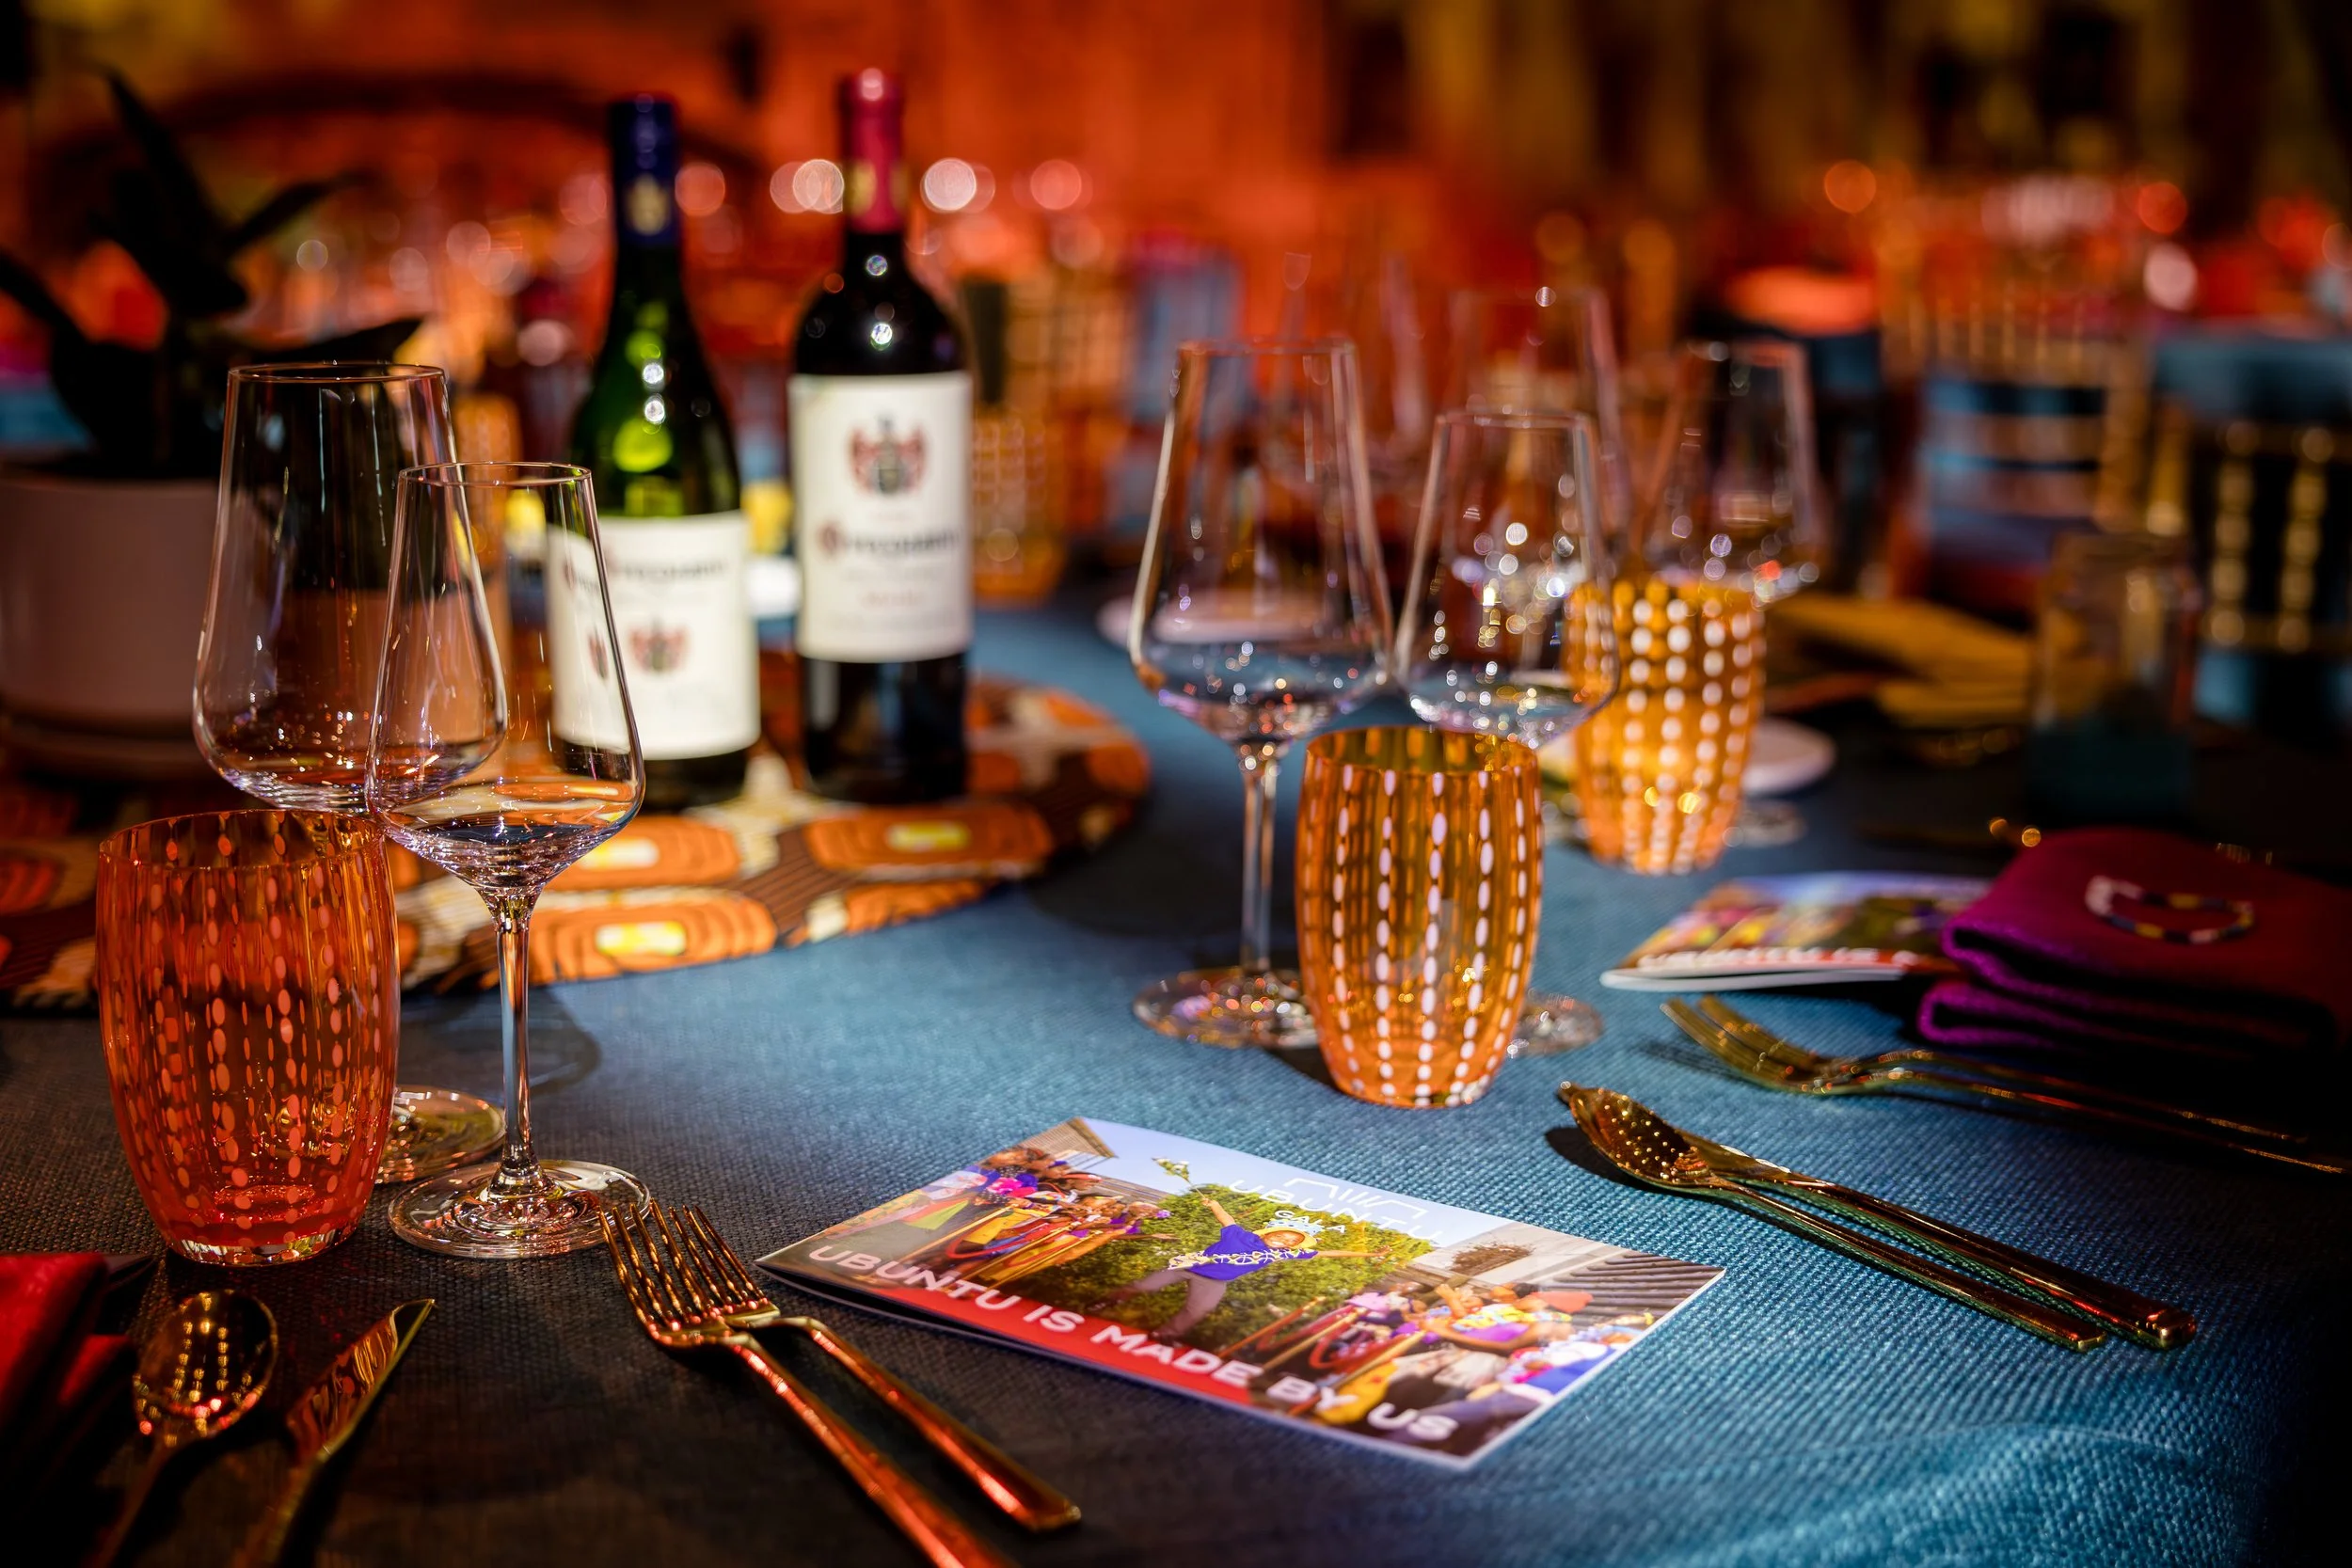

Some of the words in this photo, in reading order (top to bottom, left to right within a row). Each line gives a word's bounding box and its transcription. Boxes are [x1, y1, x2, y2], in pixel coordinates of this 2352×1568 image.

[1229, 1180, 1443, 1241] UBUNTU
[1275, 1210, 1347, 1234] GALA
[809, 1245, 1022, 1310] UBUNTU
[1023, 1305, 1085, 1333] IS
[1090, 1324, 1263, 1388] MADE
[1266, 1375, 1358, 1411] BY
[1367, 1402, 1459, 1440] US
